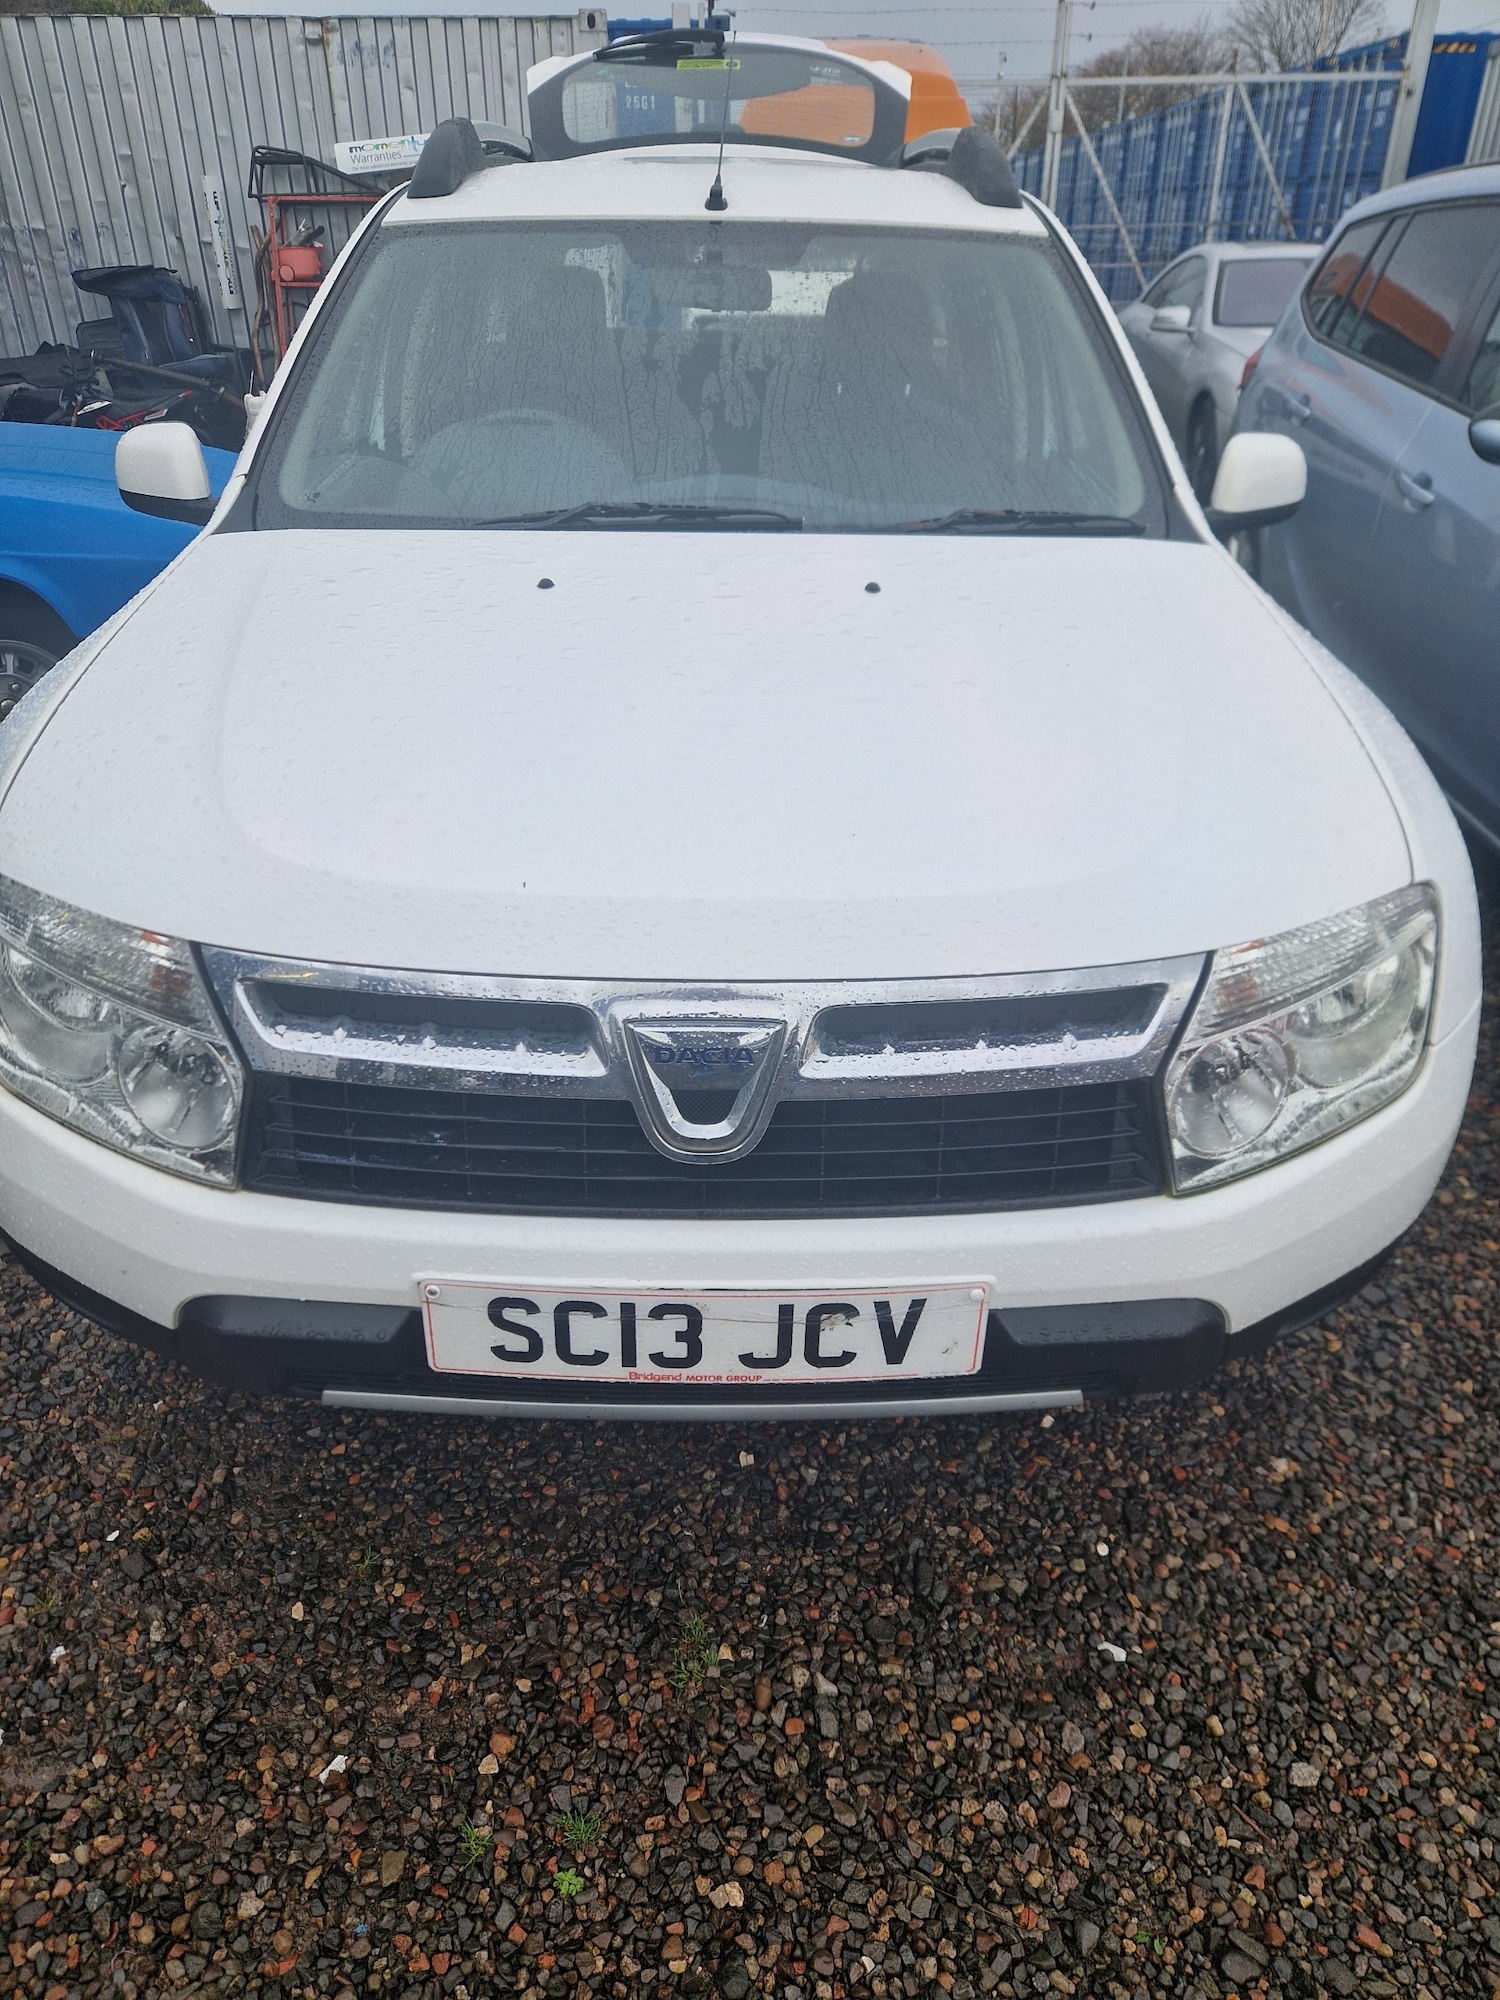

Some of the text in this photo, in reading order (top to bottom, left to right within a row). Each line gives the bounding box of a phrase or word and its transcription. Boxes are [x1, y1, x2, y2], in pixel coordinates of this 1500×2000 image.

[348, 135, 429, 154] momentu
[350, 150, 402, 164] Warranties
[654, 1047, 755, 1065] DACIA
[487, 1296, 928, 1370] SC13 JCV
[628, 1372, 682, 1382] Bridgend
